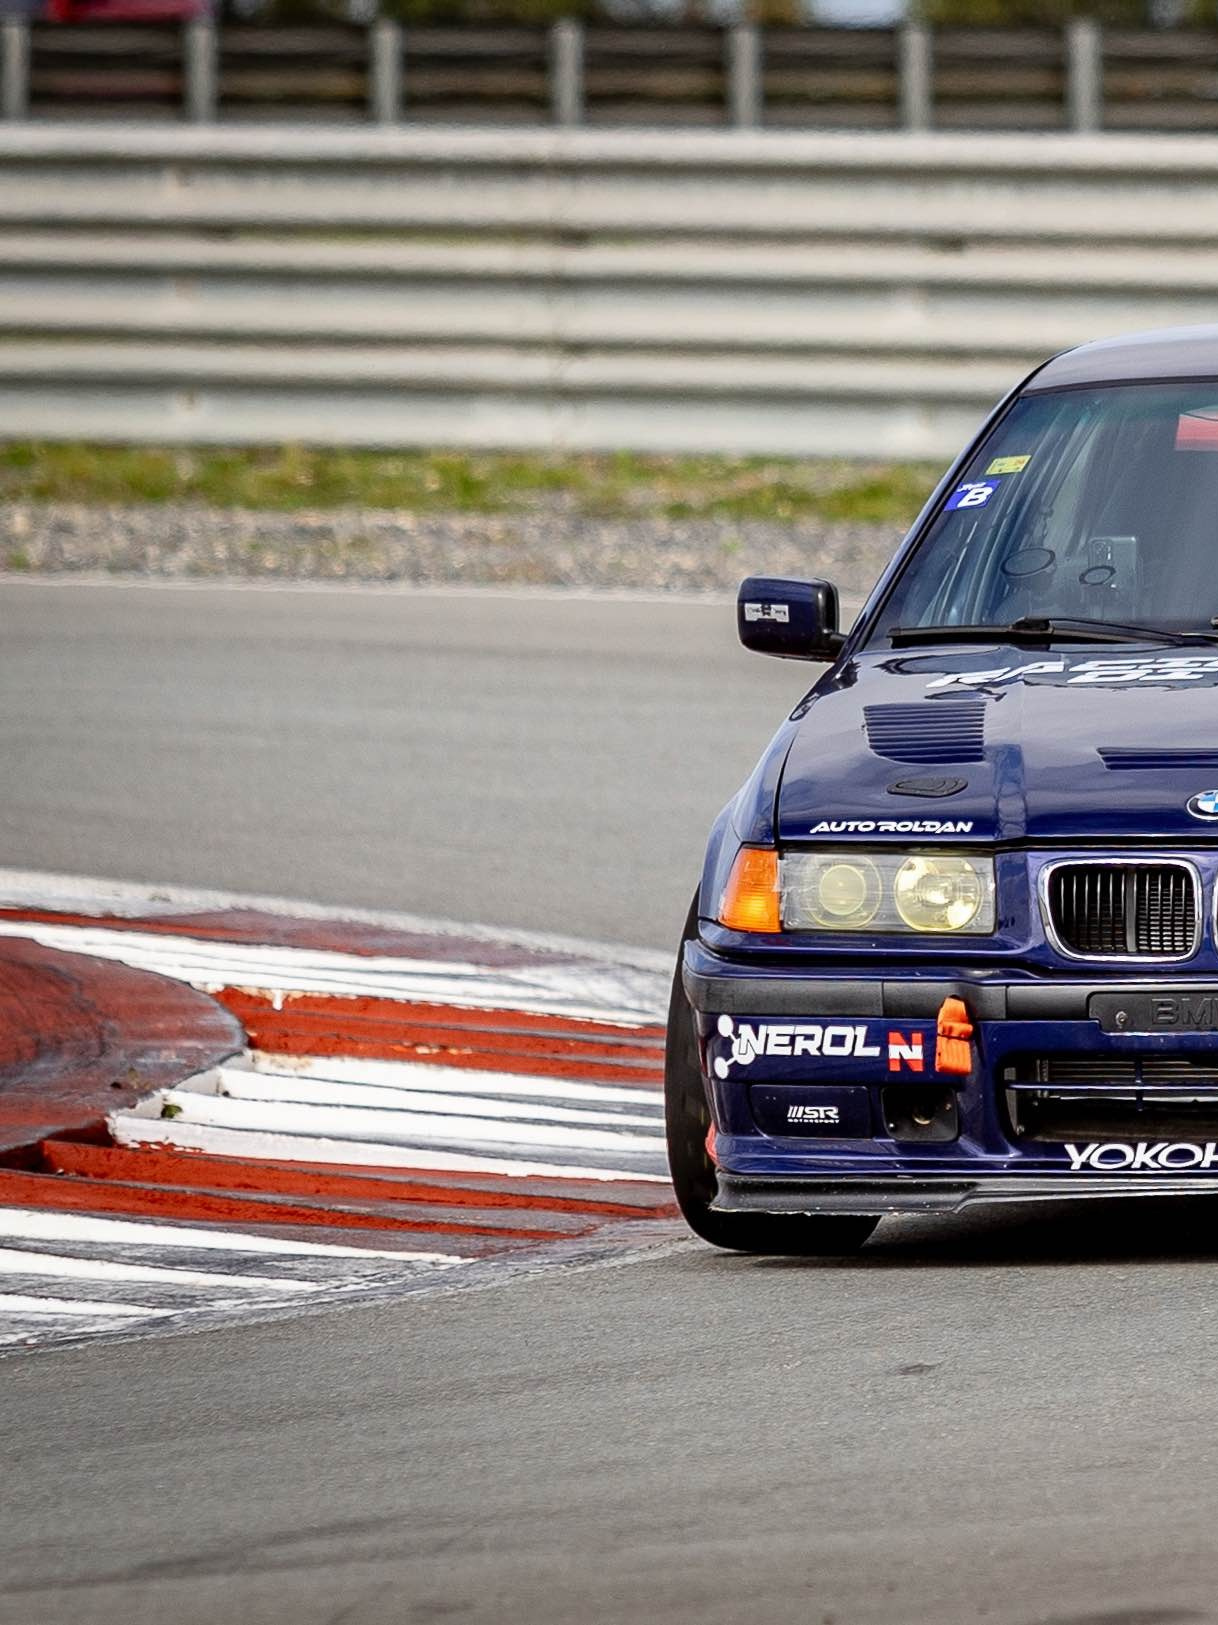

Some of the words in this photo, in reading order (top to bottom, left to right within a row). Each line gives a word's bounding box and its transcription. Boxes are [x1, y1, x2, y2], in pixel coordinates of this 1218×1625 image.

[809, 820, 876, 834] AUTO
[876, 820, 974, 833] ROLDAN
[739, 1024, 881, 1057] NEROL
[888, 1031, 923, 1072] N
